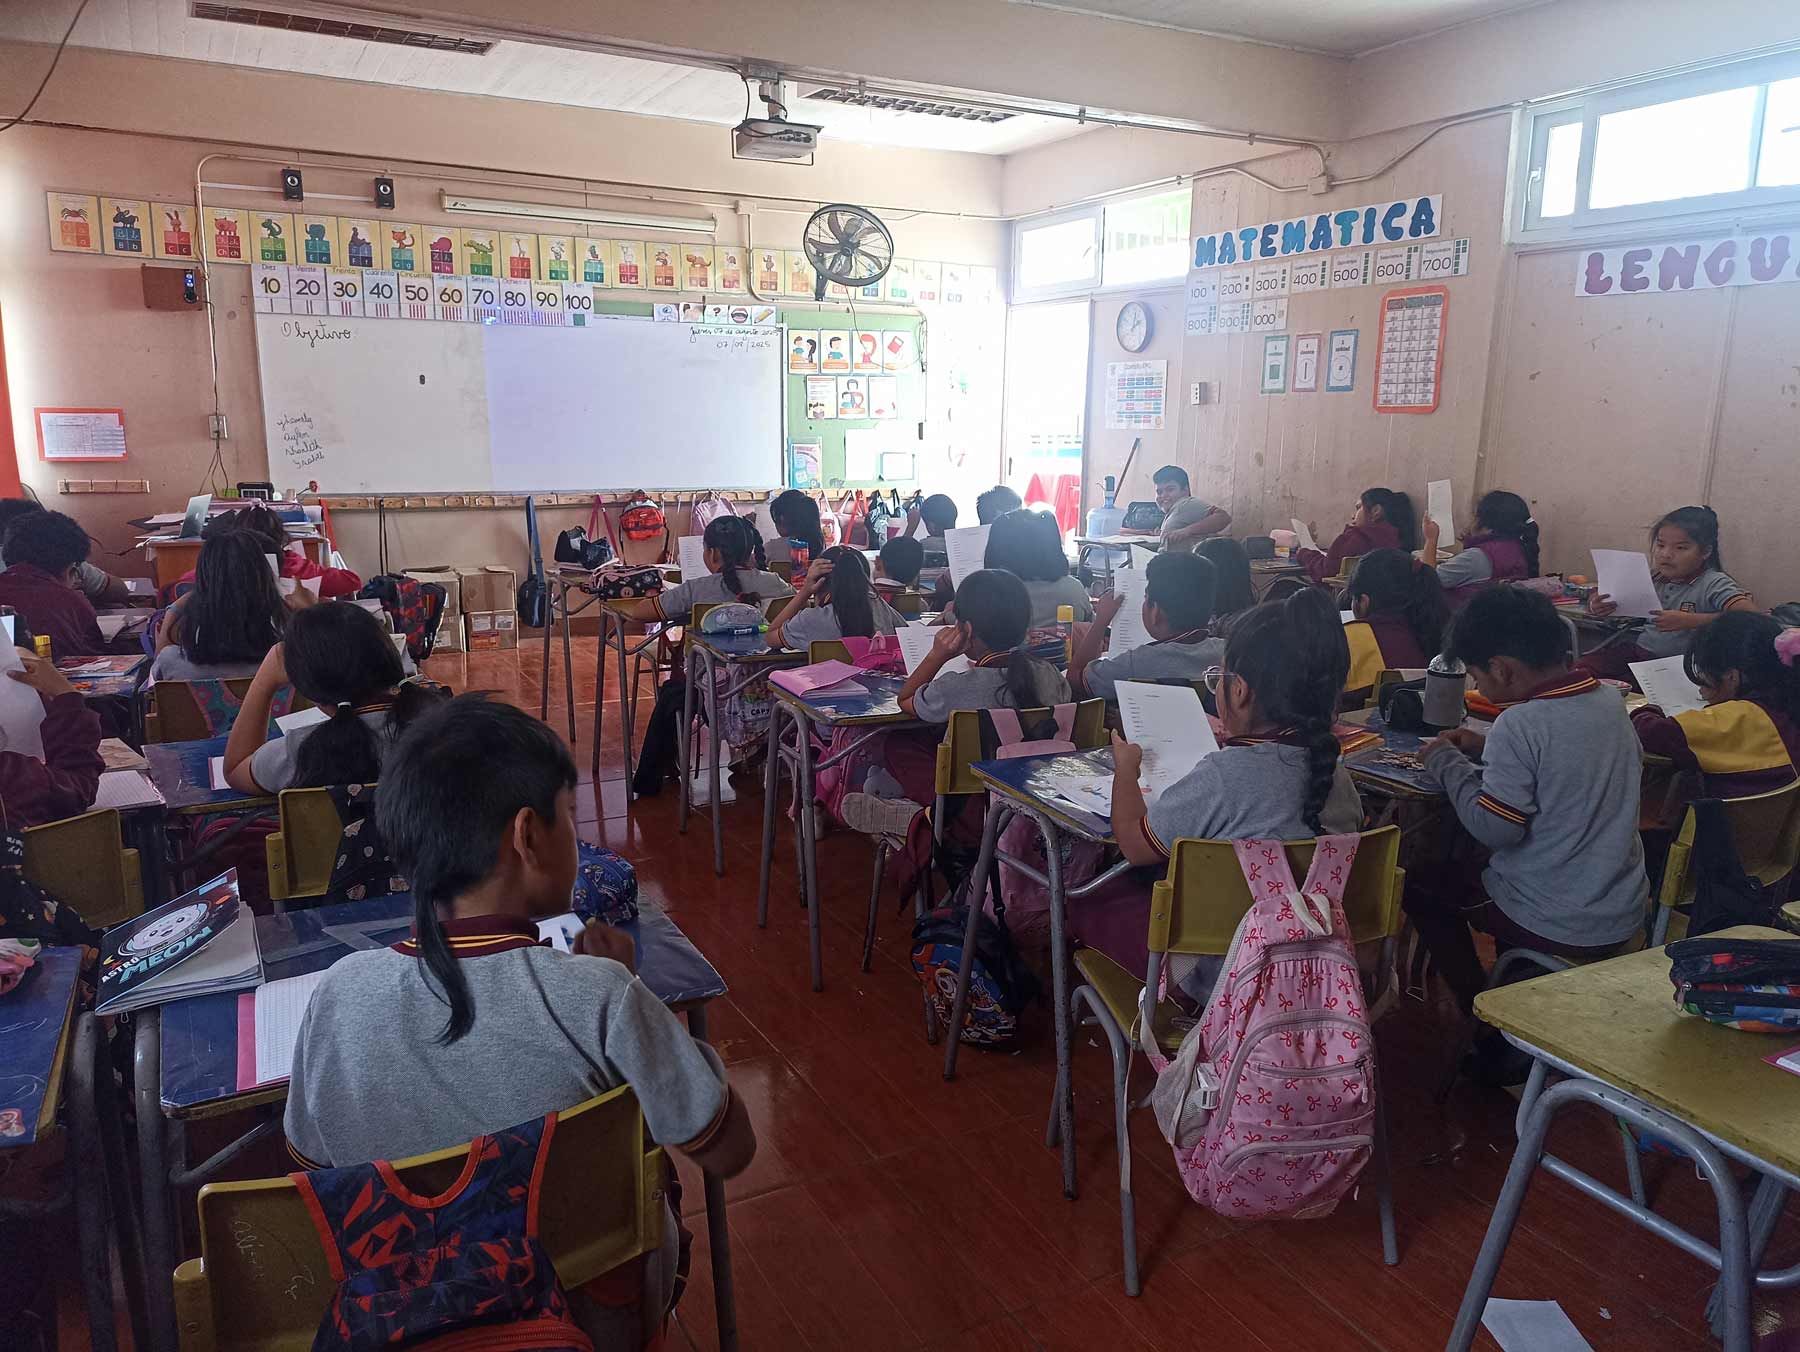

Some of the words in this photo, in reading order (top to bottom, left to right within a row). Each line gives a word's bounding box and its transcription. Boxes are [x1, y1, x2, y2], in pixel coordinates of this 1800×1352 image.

[1376, 263, 1404, 278] 600
[1423, 257, 1452, 272] 700
[1584, 234, 1800, 294] LENGU
[1293, 272, 1317, 286] 400
[1333, 268, 1360, 282] 500
[261, 277, 281, 294] 10
[295, 278, 321, 296] 20
[333, 281, 357, 298] 30
[369, 282, 393, 299] 40
[405, 285, 428, 301] 50
[1191, 287, 1207, 298] 100
[1221, 282, 1242, 295] 200
[1255, 278, 1278, 292] 300
[439, 288, 462, 303] 60
[472, 288, 494, 304] 70
[504, 291, 526, 307] 80
[536, 291, 558, 307] 90
[565, 294, 592, 310] 100
[1188, 318, 1208, 331] 800
[1253, 313, 1276, 326] 1000
[119, 926, 213, 984] MEOW
